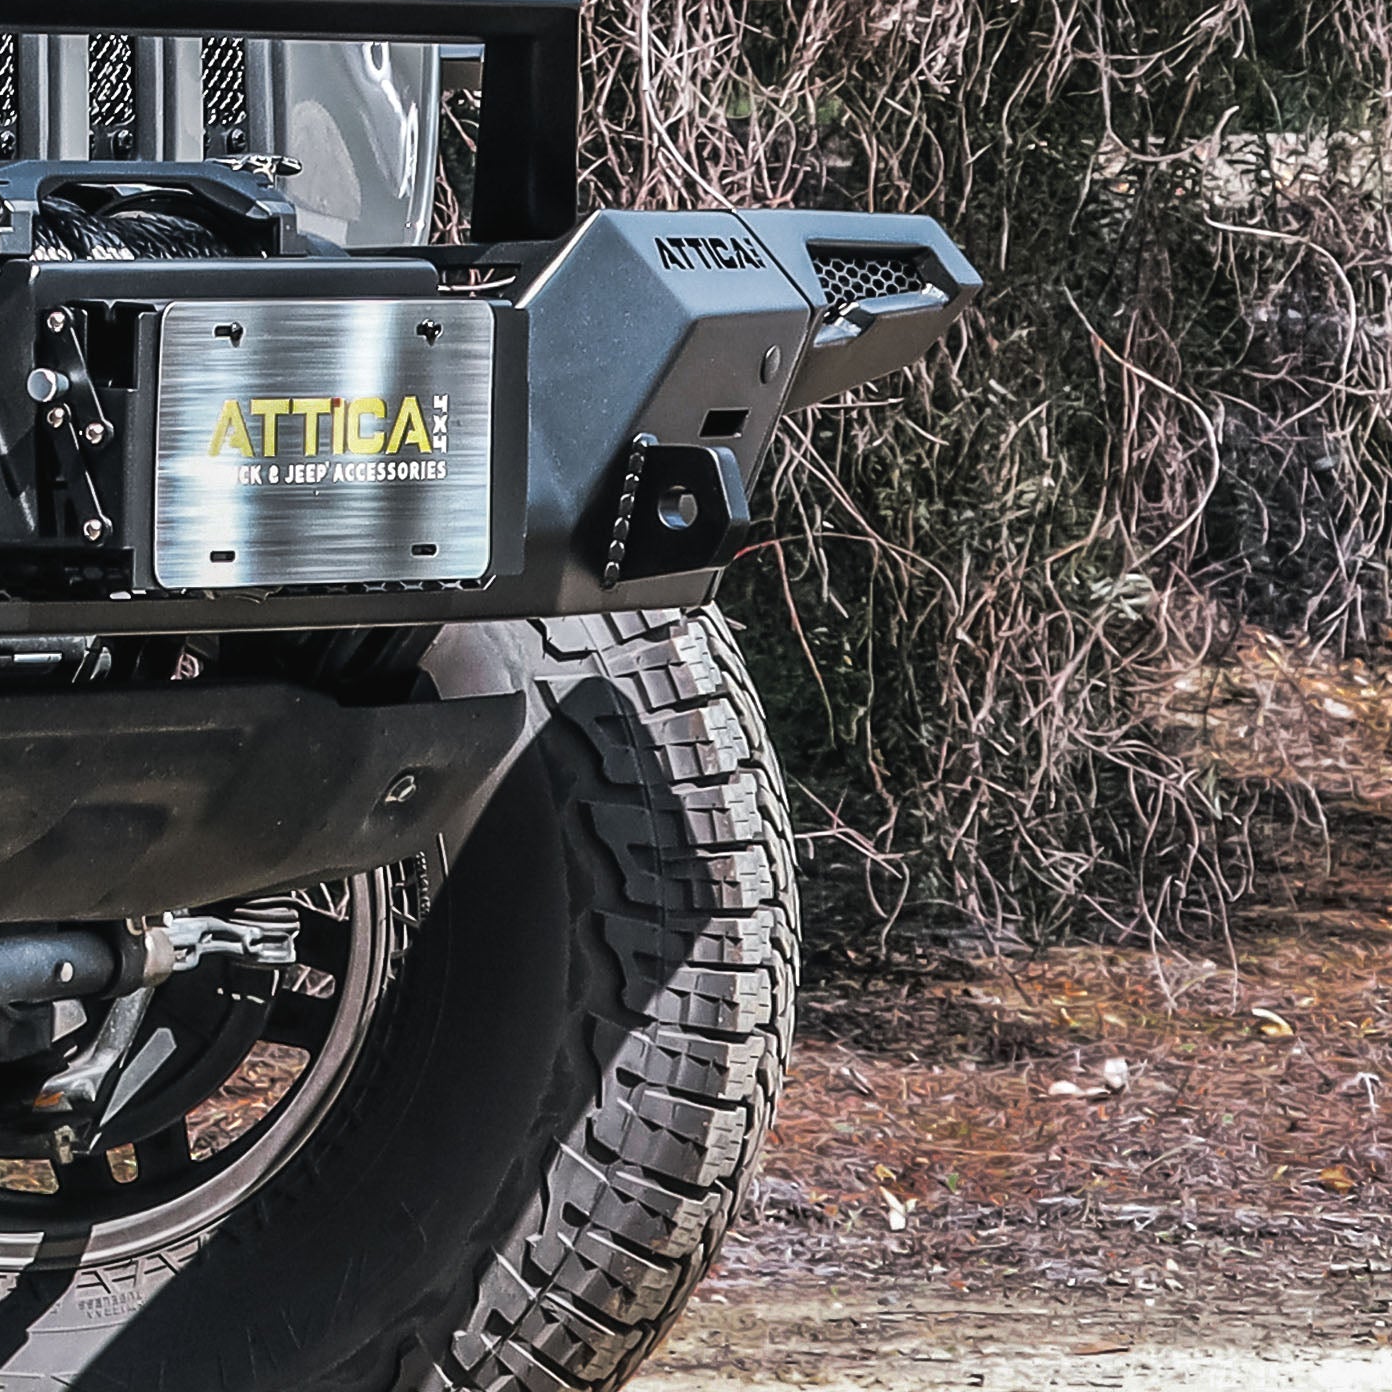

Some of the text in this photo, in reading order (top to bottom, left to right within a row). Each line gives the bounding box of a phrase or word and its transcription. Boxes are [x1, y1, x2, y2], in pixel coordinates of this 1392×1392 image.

[654, 237, 761, 269] ATTICA
[207, 394, 433, 457] ATTICA
[332, 460, 447, 483] ACCESSORIES
